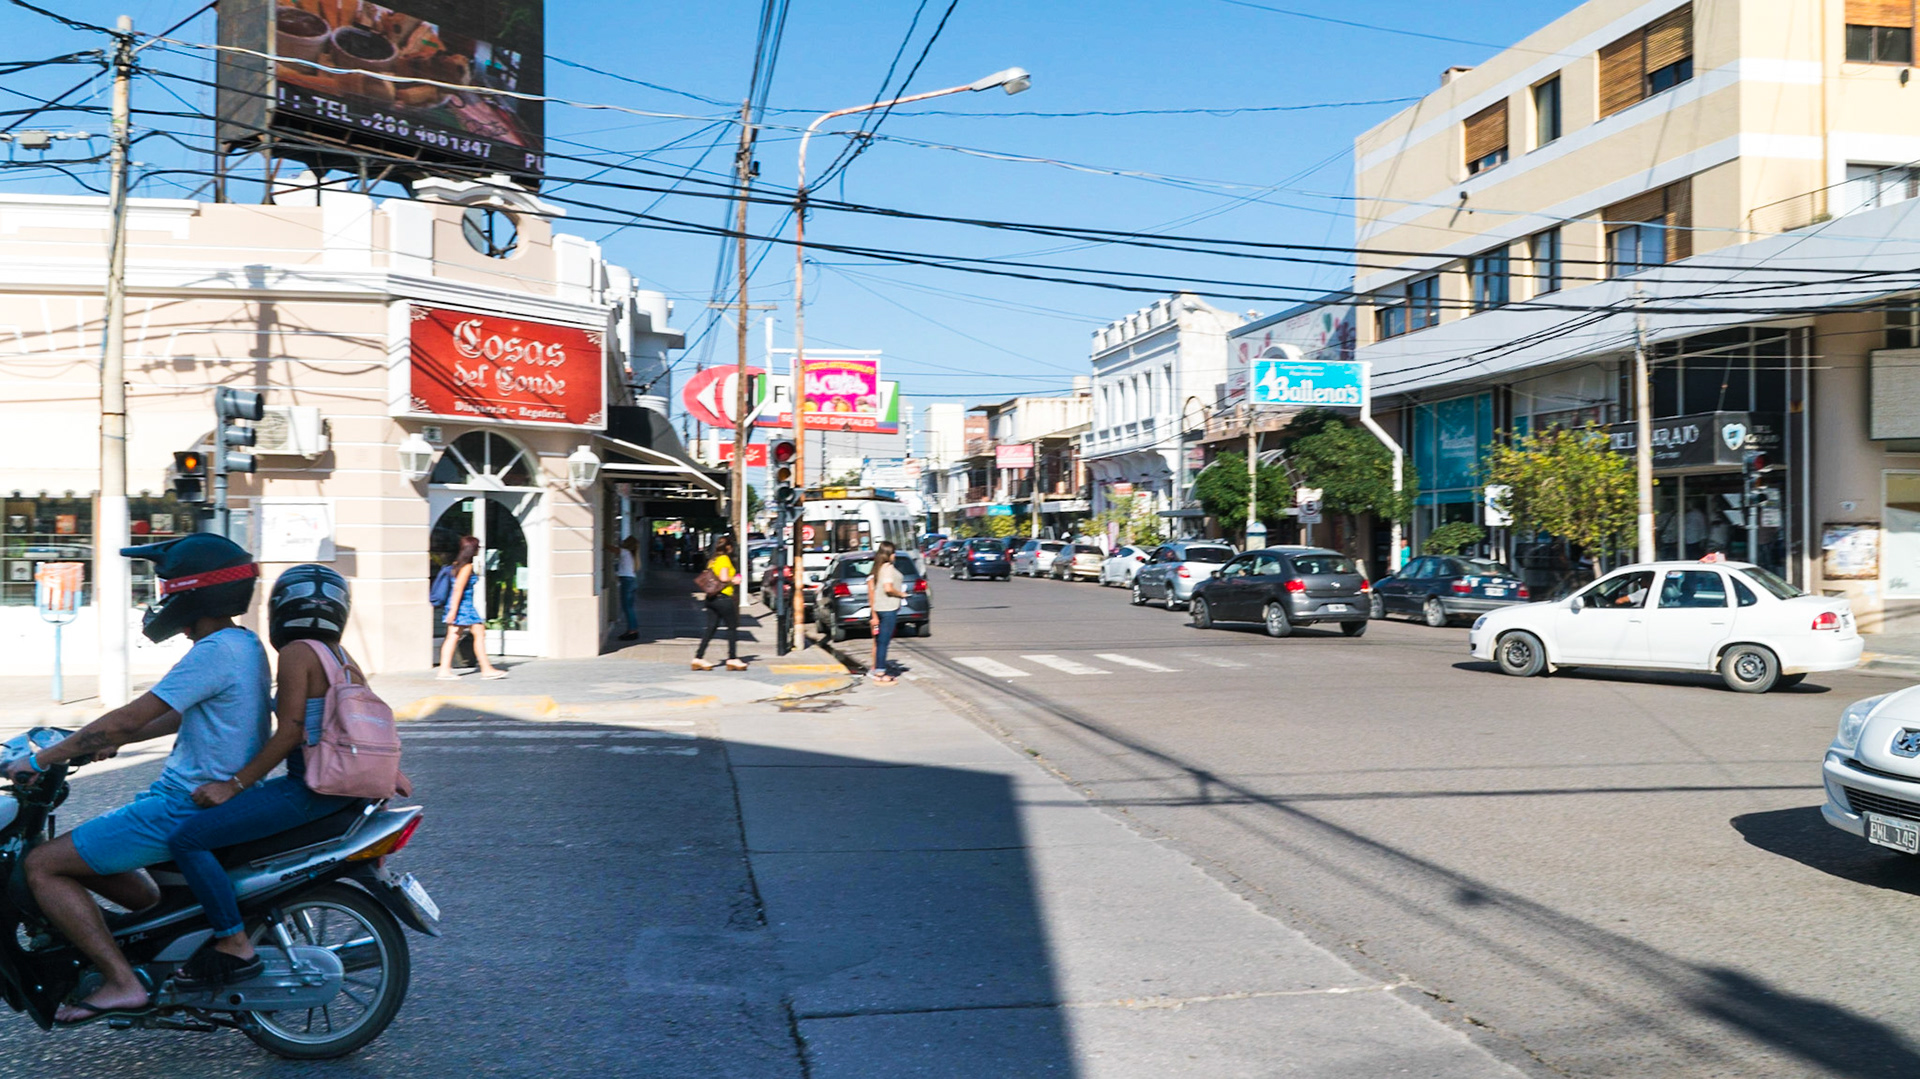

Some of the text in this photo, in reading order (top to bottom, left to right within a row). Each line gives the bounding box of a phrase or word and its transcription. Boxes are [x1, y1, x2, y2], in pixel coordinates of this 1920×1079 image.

[312, 96, 353, 123] TEL
[453, 319, 566, 367] Cosas
[453, 360, 566, 396] del Conde
[1649, 424, 1700, 448] ARAJO
[1870, 822, 1916, 848] PML 145
